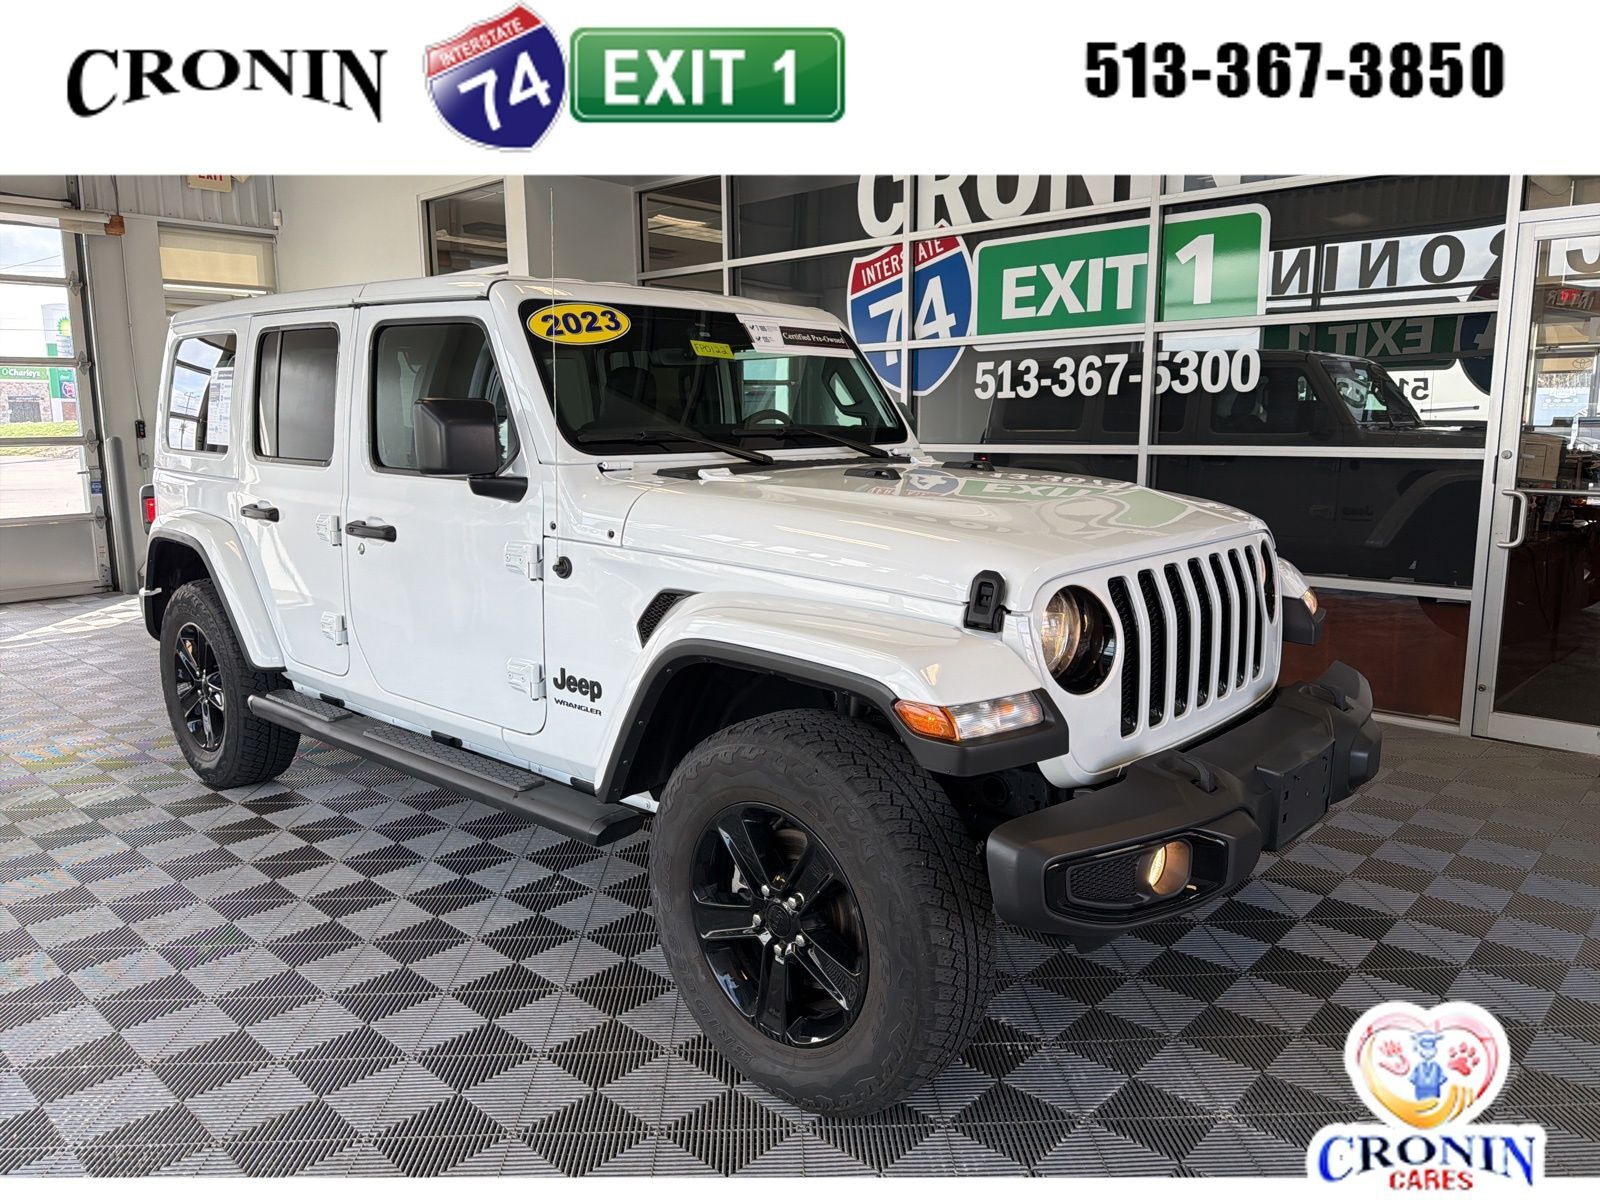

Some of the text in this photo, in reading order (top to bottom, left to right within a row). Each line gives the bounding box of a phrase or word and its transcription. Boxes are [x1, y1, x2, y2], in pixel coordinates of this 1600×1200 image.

[858, 174, 1242, 238] CRO
[857, 238, 944, 287] INTERATE
[1001, 233, 1215, 320] EXIT 1
[541, 310, 623, 337] 2023
[782, 332, 811, 342] Certified
[811, 334, 845, 345] Pre-Owned
[868, 275, 957, 367] 74
[974, 349, 1261, 400] 513-367-5300
[552, 667, 603, 703] Jeep
[554, 697, 602, 717] WRANGLER
